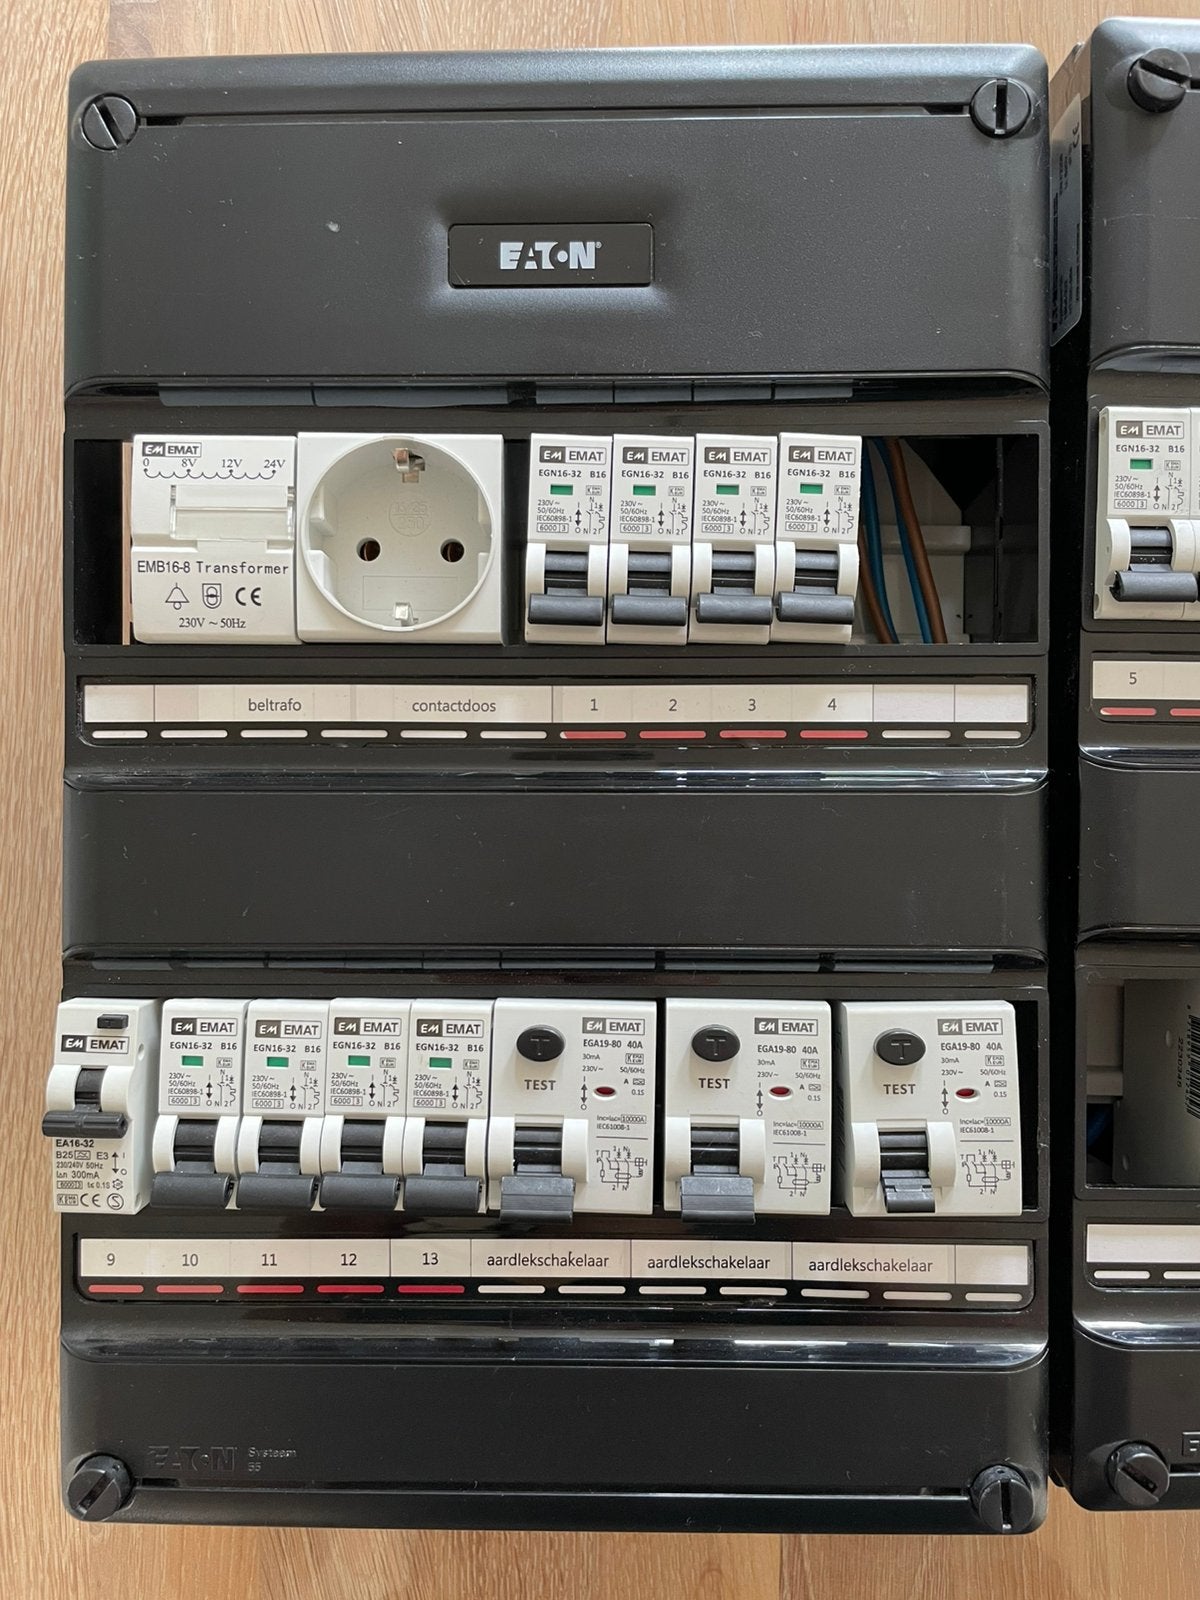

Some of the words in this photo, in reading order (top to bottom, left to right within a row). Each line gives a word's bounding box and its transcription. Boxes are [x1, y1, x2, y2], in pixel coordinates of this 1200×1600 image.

[500, 242, 596, 270] EATON
[1147, 425, 1181, 435] EMAT
[168, 446, 199, 455] EMAT
[1116, 444, 1159, 453] EGN16-32
[1169, 445, 1185, 453] B16
[569, 451, 603, 461] EMAT
[652, 451, 686, 462] EMAT
[734, 451, 768, 462] EMAT
[818, 451, 852, 461] EMAT
[182, 459, 197, 467] 8V
[222, 459, 243, 468] 12V
[264, 459, 286, 468] 24V
[539, 469, 582, 478] EGN16-32
[590, 471, 607, 479] B16
[621, 470, 664, 479] EGN16-32
[673, 471, 689, 479] B16
[703, 470, 746, 479] EGN16-32
[755, 471, 771, 479] B16
[787, 469, 830, 478] EGN16-32
[839, 471, 856, 479] B16
[1117, 500, 1135, 508] 6000
[786, 506, 813, 514] 50/60Hz
[704, 524, 722, 532] 6000
[138, 561, 191, 573] EMB16-8
[196, 562, 289, 574] Transformer
[179, 618, 205, 628] 230V
[221, 619, 246, 628] 50Hz
[1130, 672, 1137, 684] 5
[249, 698, 301, 711] beltrafo
[412, 699, 496, 712] contactdoos
[591, 699, 598, 711] 1
[669, 699, 677, 711] 2
[748, 699, 756, 711] 3
[828, 698, 836, 710] 4
[200, 1022, 234, 1033] EMAT
[284, 1025, 318, 1035] EMAT
[364, 1022, 398, 1032] EMAT
[446, 1024, 480, 1034] EMAT
[610, 1022, 641, 1032] EMAT
[782, 1022, 814, 1032] EMAT
[966, 1022, 998, 1032] EMAT
[91, 1040, 126, 1050] EMAT
[170, 1041, 213, 1050] EGN16-32
[221, 1042, 237, 1050] B16
[253, 1044, 296, 1053] EGN16-32
[305, 1045, 321, 1053] B16
[333, 1041, 376, 1050] EGN16-32
[384, 1042, 401, 1050] B16
[416, 1043, 459, 1052] EGN16-32
[468, 1044, 484, 1052] B16
[583, 1040, 622, 1048] EGA19-80
[627, 1041, 643, 1049] 40A
[758, 1045, 796, 1054] EGA19-80
[802, 1046, 818, 1054] 40A
[941, 1043, 980, 1051] EGA19-80
[986, 1043, 1003, 1051] 40A
[620, 1066, 645, 1074] 50/60Hz
[524, 1080, 556, 1091] TEST
[698, 1078, 731, 1089] TEST
[884, 1084, 916, 1095] TEST
[56, 1140, 95, 1148] EA16-32
[57, 1151, 73, 1159] B25
[97, 1152, 109, 1160] E3
[72, 1171, 100, 1179] 300mA
[107, 1253, 115, 1266] 9
[183, 1254, 198, 1266] 10
[262, 1254, 277, 1266] 11
[341, 1254, 356, 1265] 12
[423, 1253, 438, 1265] 13
[487, 1251, 609, 1266] aardlekschakelaar
[648, 1256, 770, 1268] aardlekschakelaar
[809, 1258, 932, 1271] aardlekschakelaar
